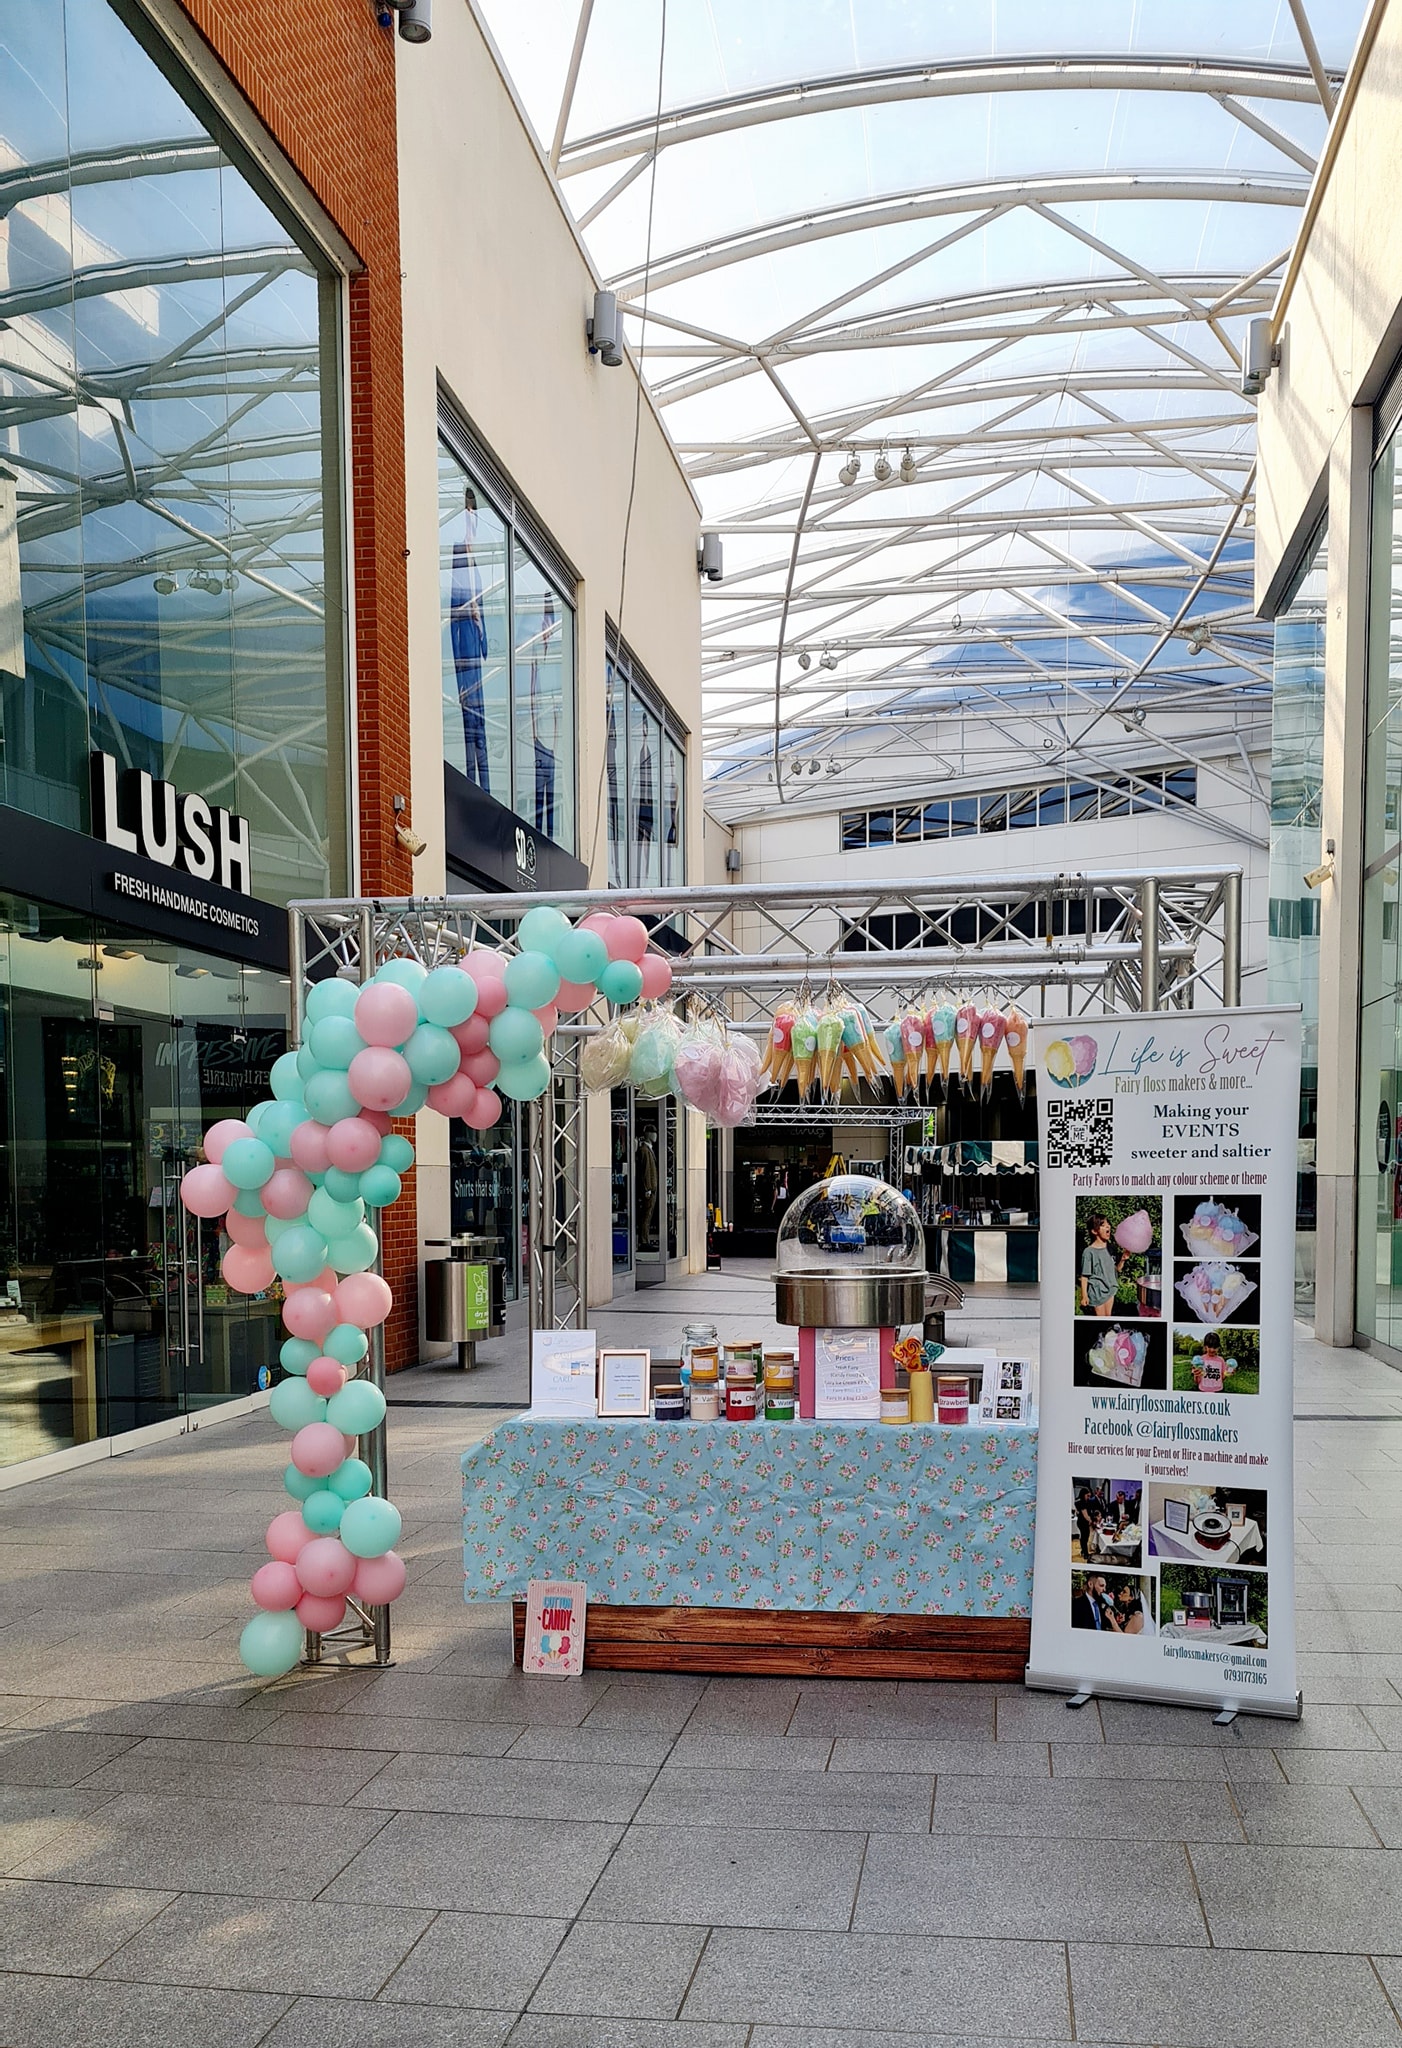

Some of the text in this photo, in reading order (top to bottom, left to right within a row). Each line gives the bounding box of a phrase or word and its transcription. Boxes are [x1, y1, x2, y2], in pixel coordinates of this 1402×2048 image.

[90, 751, 251, 896] LUSH
[114, 872, 259, 936] FRESH HANDMADE COSMETICS
[1098, 1024, 1285, 1075] Life is Sweet
[1115, 1073, 1252, 1095] Fairy floss makers & more...
[1153, 1104, 1249, 1120] Making your
[1073, 1132, 1085, 1140] ME
[1162, 1123, 1240, 1138] EVENTS
[1131, 1143, 1271, 1159] sweeter and saltier
[454, 1178, 474, 1197] Shirts
[475, 1178, 487, 1197] that
[1073, 1172, 1267, 1188] Party Favors to match any colour scheme or theme
[552, 1375, 573, 1383] CARD
[1092, 1394, 1231, 1417] www.fairyflossmakers.co.uk
[1085, 1418, 1238, 1443] Facebook @fairyflossmakers
[1068, 1442, 1269, 1465] Hire our services for your Event or Hire a machine and make
[1145, 1463, 1189, 1477] it yourselves!
[542, 1608, 573, 1631] CANDY
[1164, 1645, 1267, 1668] fairyflossmakers@gmail.com
[1224, 1669, 1267, 1685] 07931773165
